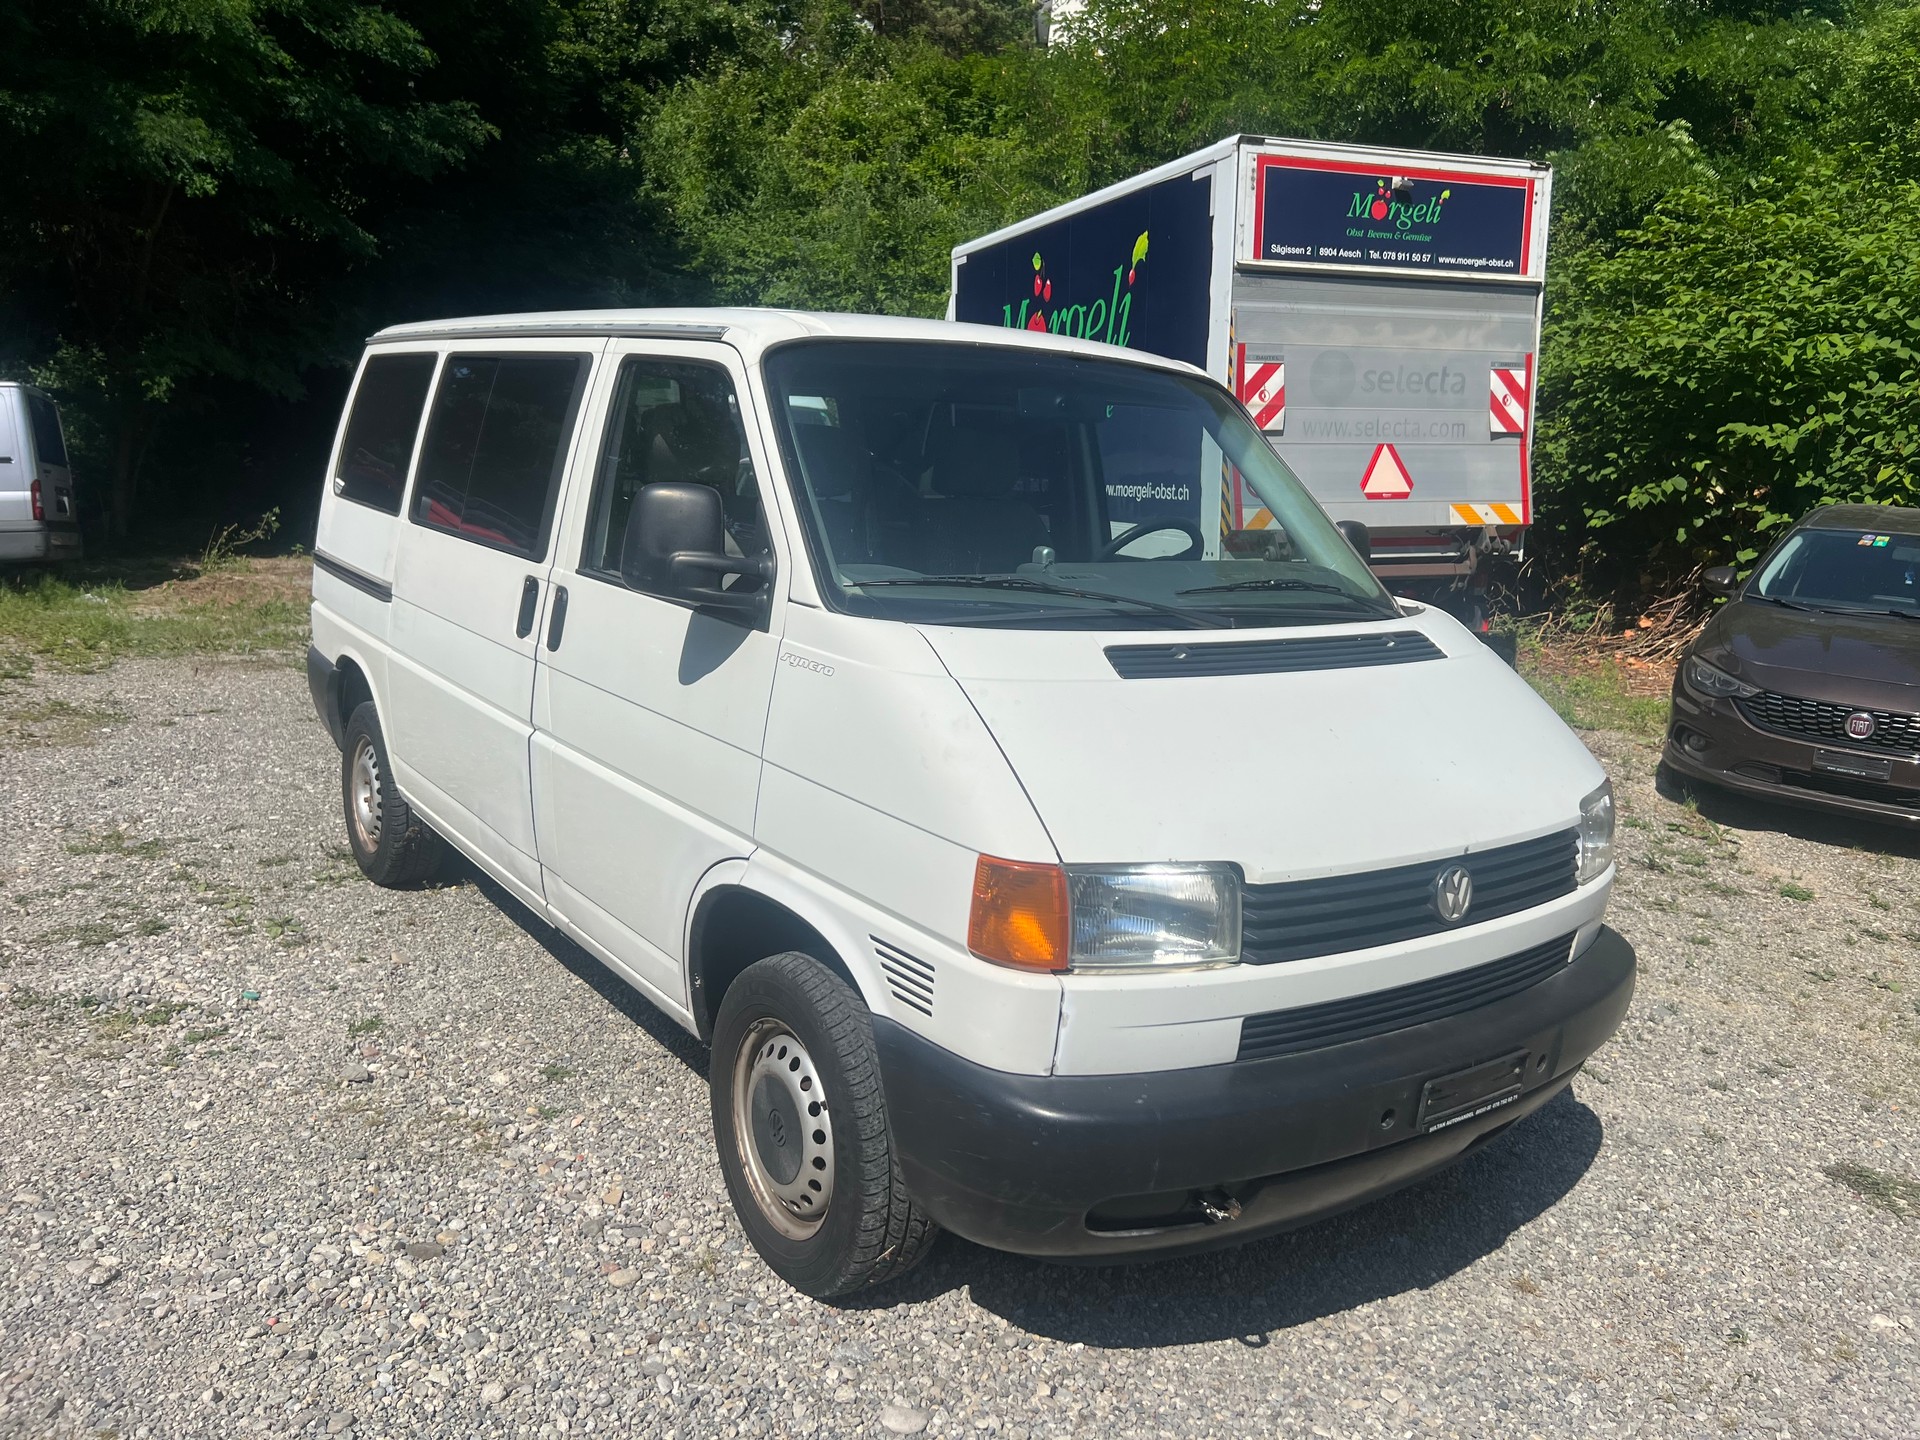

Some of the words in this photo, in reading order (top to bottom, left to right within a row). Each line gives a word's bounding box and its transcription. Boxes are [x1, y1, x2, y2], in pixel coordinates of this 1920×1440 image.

[1346, 227, 1364, 238] Obst
[1367, 229, 1393, 240] Beeren
[1394, 231, 1401, 241] &
[1402, 232, 1432, 243] Gemüse
[1270, 243, 1305, 256] Sägissen
[1306, 246, 1312, 256] 2
[1319, 247, 1337, 257] 8904
[1338, 248, 1362, 258] Aesch
[1369, 250, 1381, 260] Tel.
[1382, 251, 1396, 260] 078
[1397, 251, 1410, 261] 911
[1411, 253, 1421, 262] 50
[1421, 253, 1431, 263] 57
[1438, 255, 1514, 268] www.moergeli-obst.ch
[1361, 365, 1466, 396] selecta
[1303, 416, 1466, 439] www.selecta.com
[780, 652, 835, 677] syncro
[1851, 719, 1870, 733] FIAT
